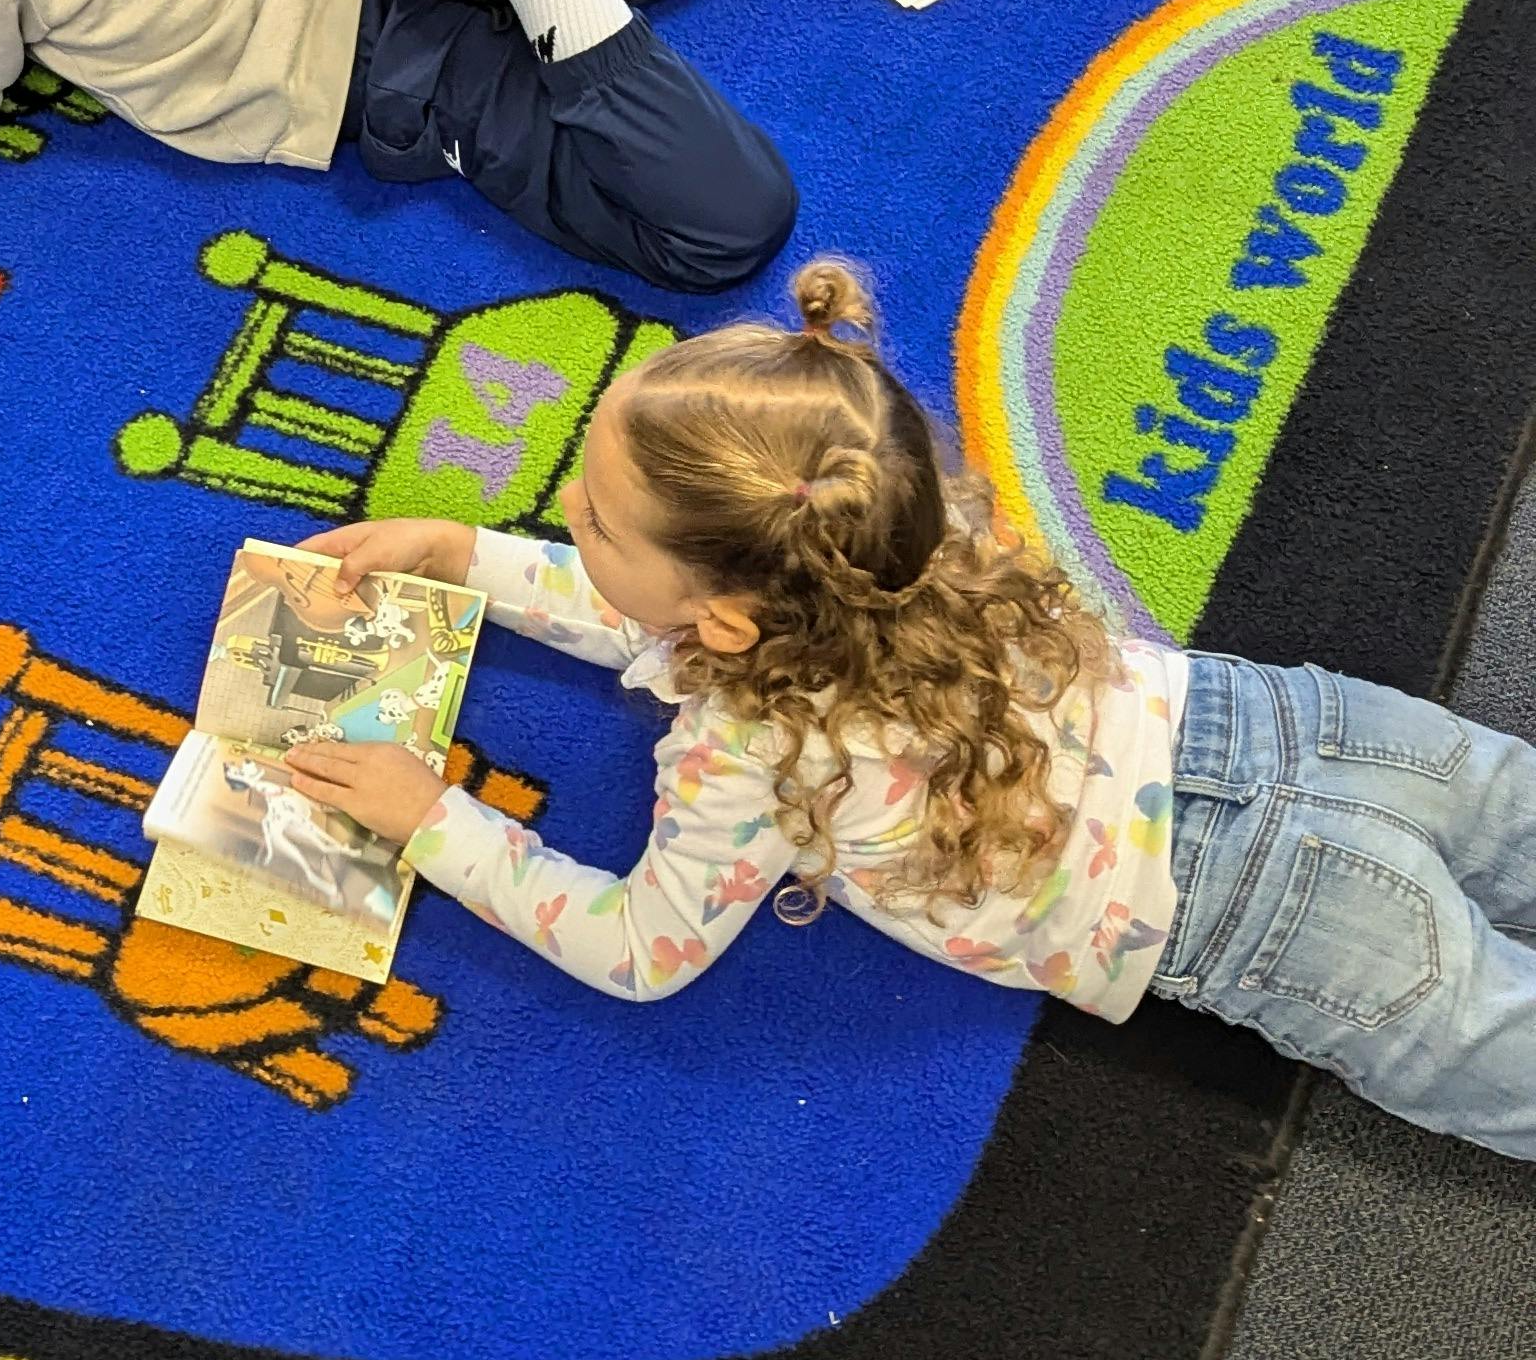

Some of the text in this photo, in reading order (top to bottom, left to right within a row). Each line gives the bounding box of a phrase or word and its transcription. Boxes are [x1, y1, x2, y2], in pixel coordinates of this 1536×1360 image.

[416, 345, 563, 492] 14
[1102, 33, 1402, 533] kids world
